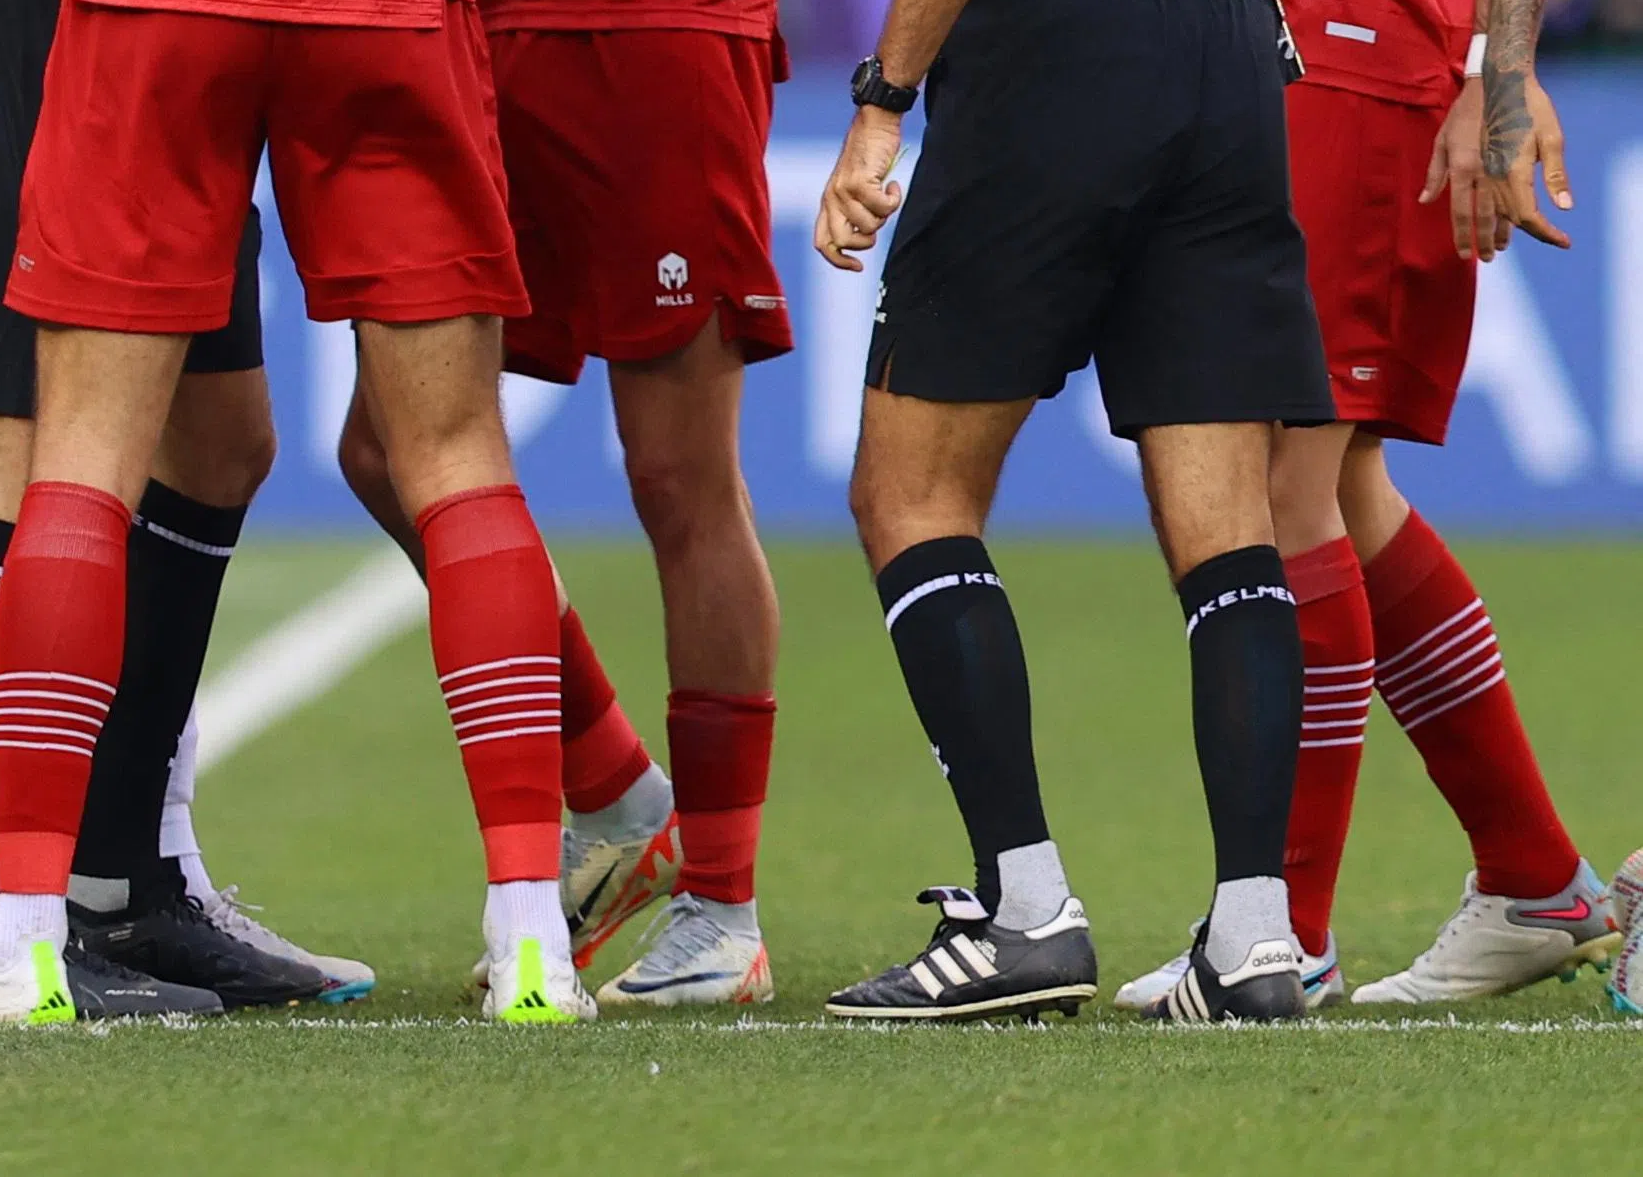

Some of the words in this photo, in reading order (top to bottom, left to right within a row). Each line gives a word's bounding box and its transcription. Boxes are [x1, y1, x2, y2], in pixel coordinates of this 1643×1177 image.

[655, 292, 695, 307] MILLS
[964, 572, 1004, 589] KEL
[1199, 584, 1288, 618] KELME
